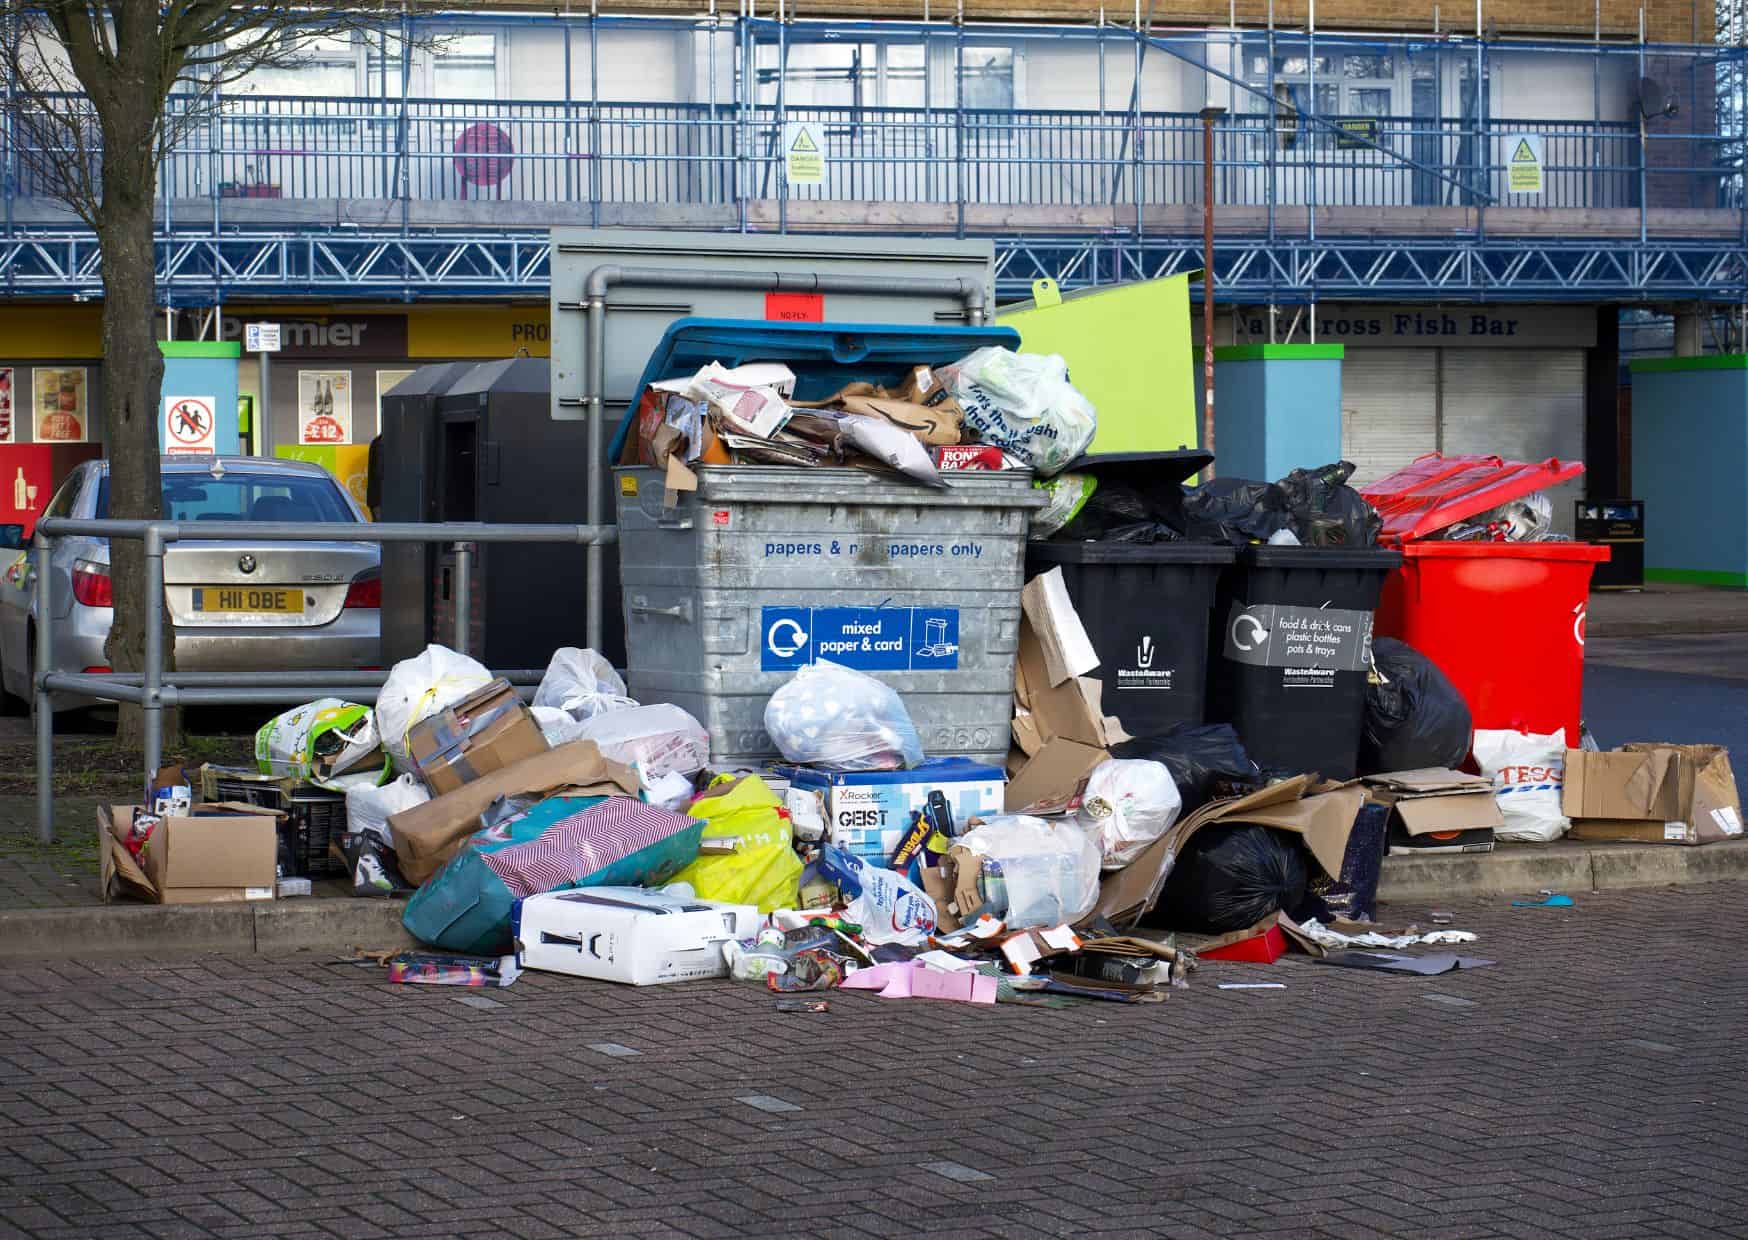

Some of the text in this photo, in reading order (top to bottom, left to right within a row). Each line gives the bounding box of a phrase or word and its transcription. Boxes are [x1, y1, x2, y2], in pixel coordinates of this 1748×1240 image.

[220, 315, 367, 346] Pmier
[1303, 314, 1381, 335] Cross
[1393, 314, 1457, 335] Fish
[1469, 314, 1518, 336] Bar
[765, 540, 983, 558] papers & nspapers only
[247, 591, 287, 609] OBE
[842, 620, 881, 635] mixed
[1279, 617, 1298, 629] food
[1300, 618, 1309, 629] &
[1333, 623, 1352, 633] cans
[820, 636, 903, 654] paper & card
[1286, 631, 1341, 644] plastic bottles
[1287, 644, 1336, 657] pots & trays
[1118, 669, 1171, 677] WasteAware
[1284, 667, 1335, 676] WasteAware
[1498, 765, 1563, 785] TESC
[839, 809, 888, 827] GEIST
